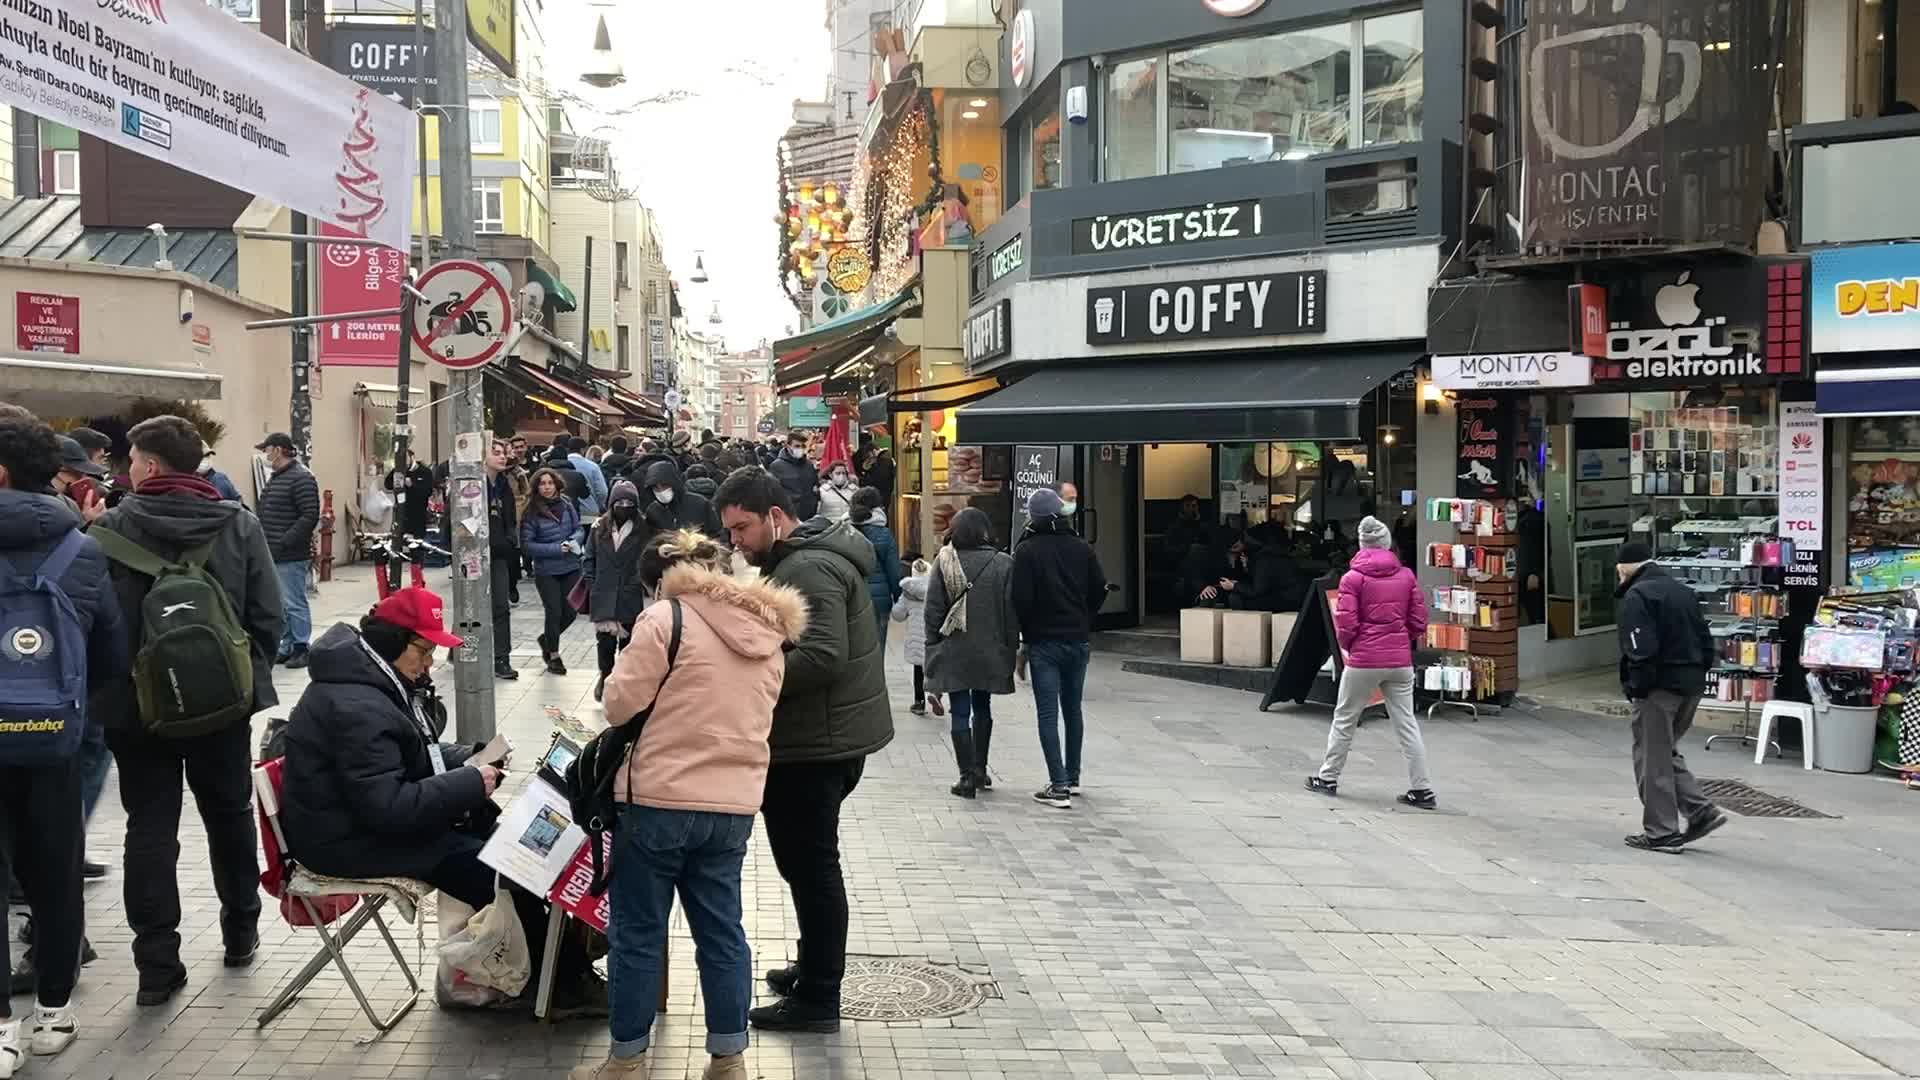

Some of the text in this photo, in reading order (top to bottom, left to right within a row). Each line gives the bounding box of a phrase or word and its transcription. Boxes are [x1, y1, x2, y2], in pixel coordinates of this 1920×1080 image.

[57, 8, 90, 42] Noel
[95, 25, 165, 75] Bayramı'nı
[170, 60, 220, 101] kutluyor;
[223, 89, 267, 122] sağlıkla,
[350, 42, 428, 70] COFF
[16, 60, 46, 82] Şerdil
[48, 73, 71, 93] Dara
[71, 83, 116, 112] ODABAŞI
[52, 41, 86, 72] dolu
[90, 55, 108, 80] bir
[112, 65, 160, 103] bayram
[164, 91, 239, 136] geçirmelerini
[241, 122, 291, 157] diliyorum.
[1091, 203, 1240, 250] ÜCRETSİZ
[30, 296, 63, 306] REKLAM
[42, 306, 54, 315] VE
[1149, 279, 1272, 335] COFFY
[346, 322, 365, 331] 200
[1460, 354, 1558, 376] MONTAG
[1028, 453, 1042, 469] AÇ
[1016, 468, 1054, 485] GÖZÜNÜ
[1785, 520, 1817, 531] TCL
[1783, 573, 1819, 586] SERVİS
